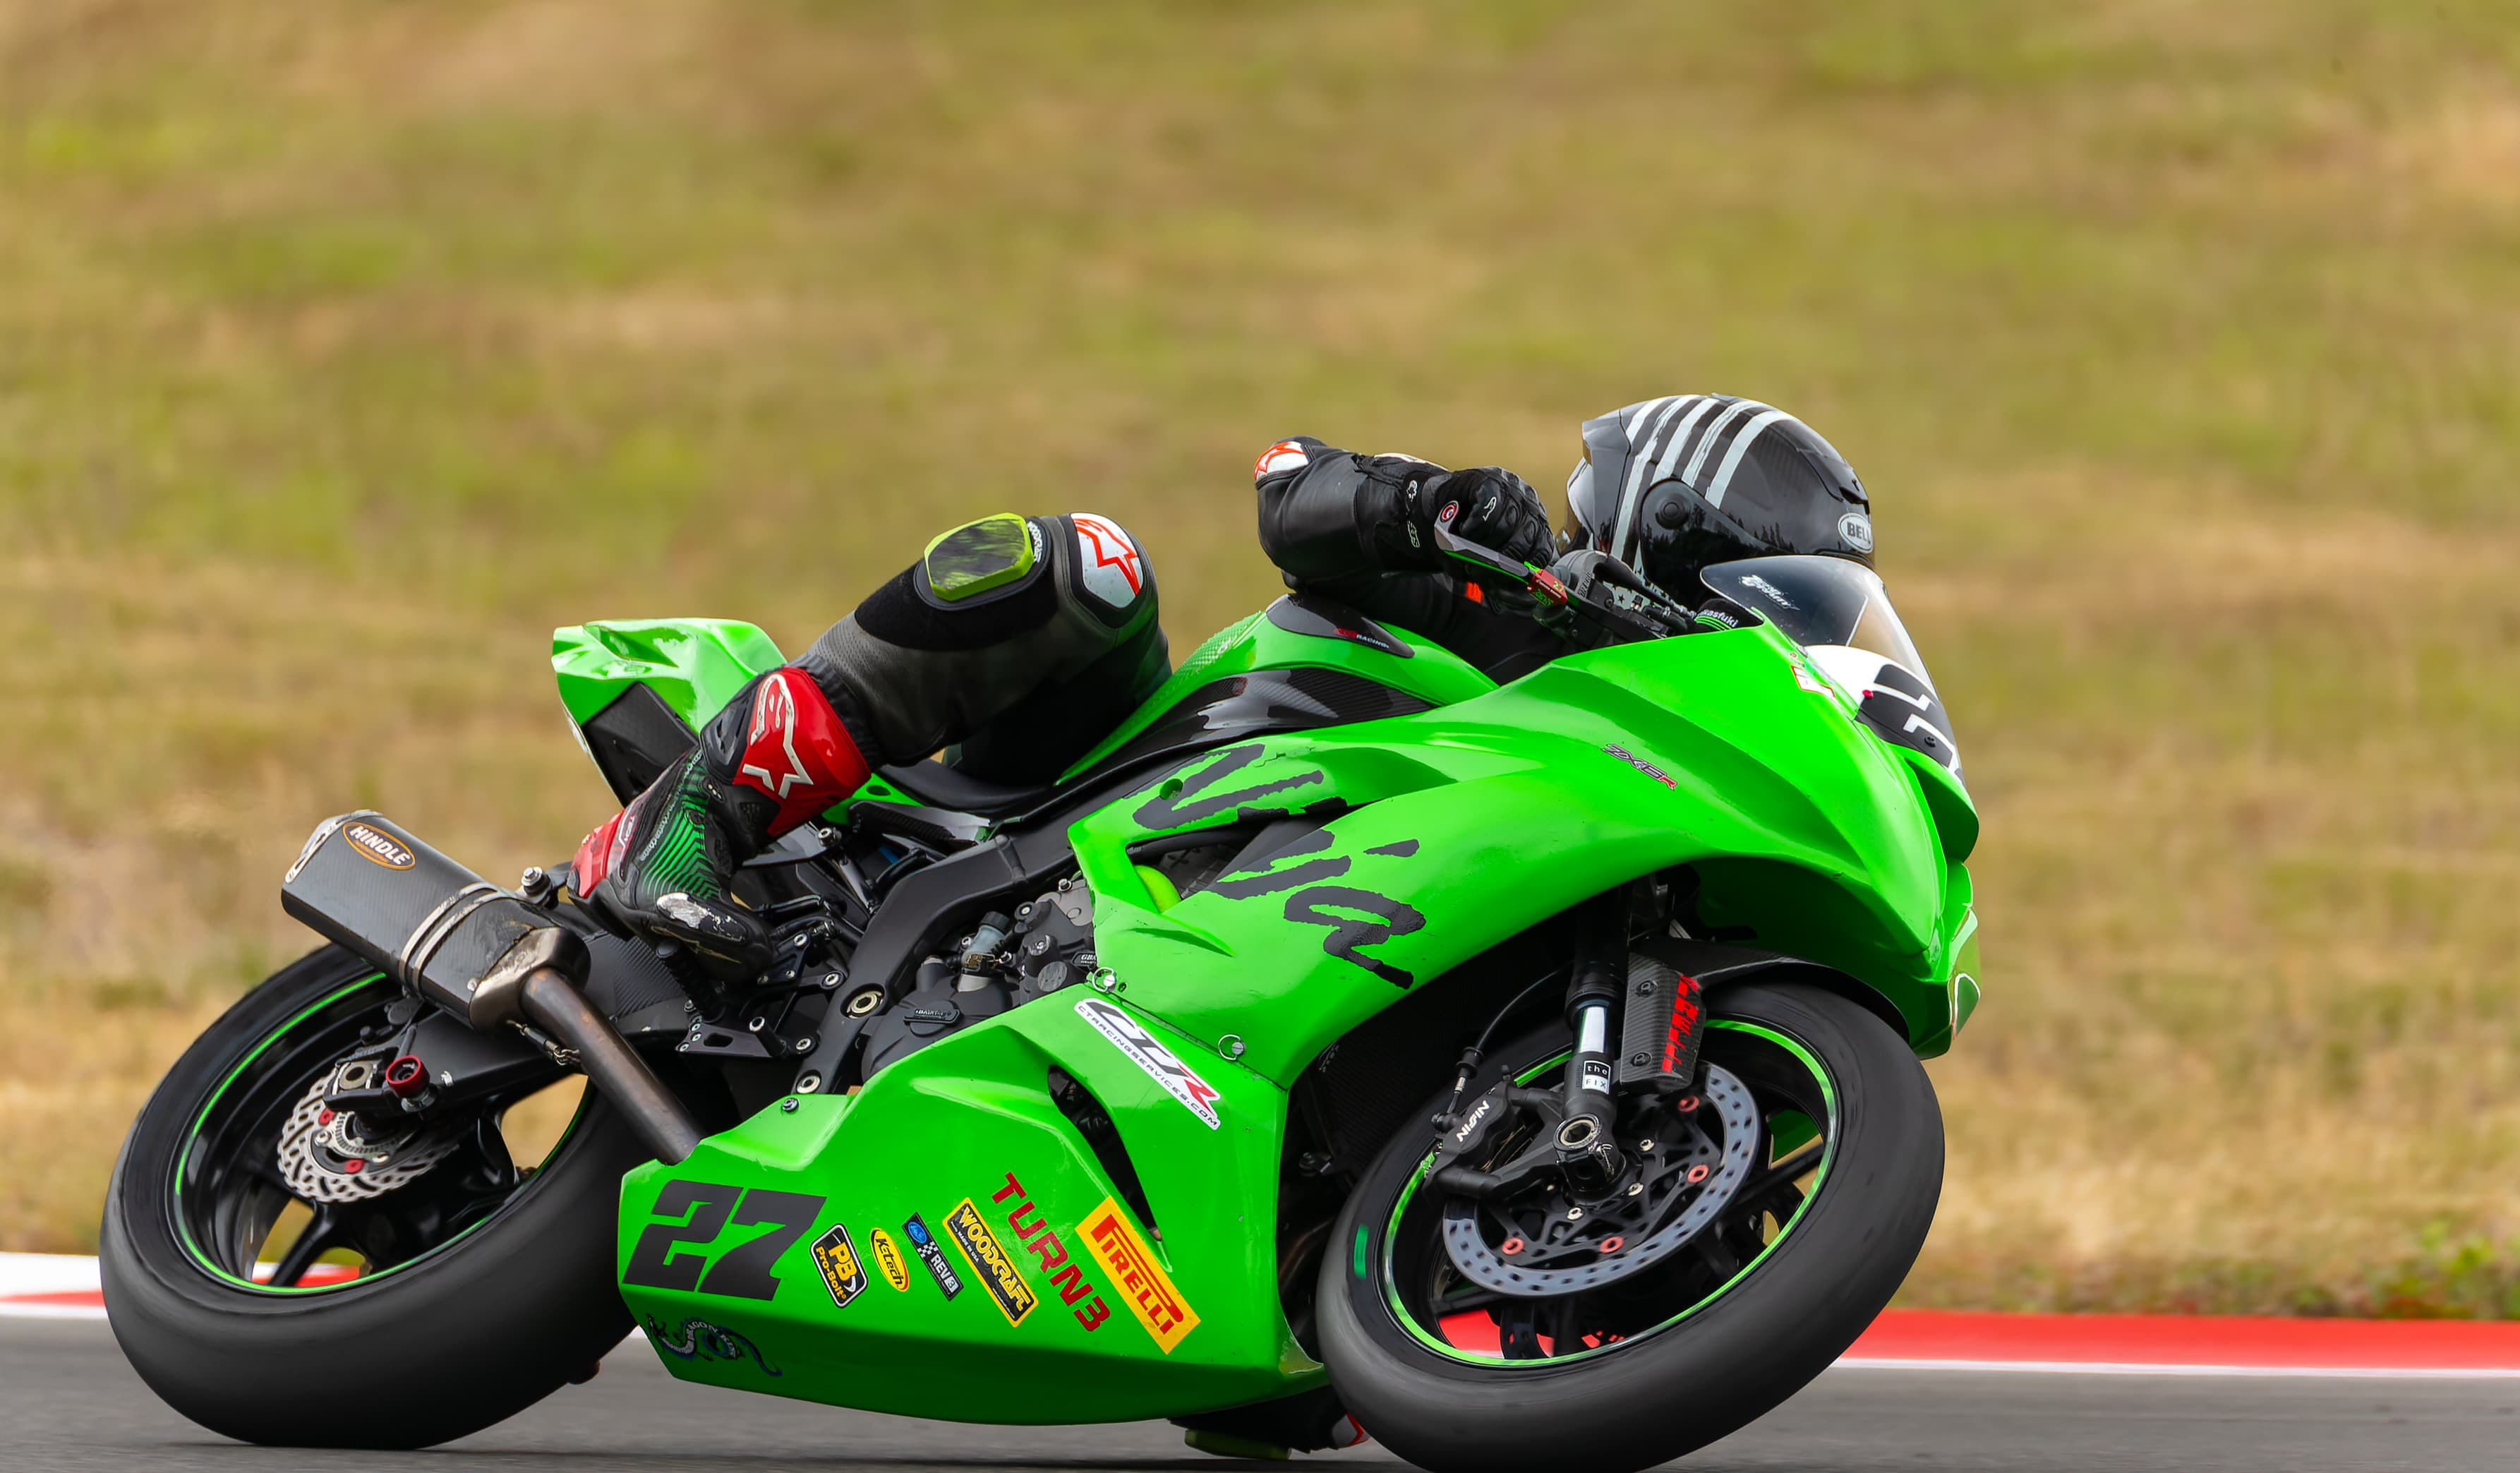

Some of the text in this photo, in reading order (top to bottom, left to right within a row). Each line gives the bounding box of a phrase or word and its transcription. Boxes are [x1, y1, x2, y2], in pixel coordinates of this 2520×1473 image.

[1847, 521, 1871, 545] BELL
[1356, 634, 1387, 648] RACING
[349, 825, 411, 865] HINDLE
[1078, 1005, 1219, 1127] CTRACINGSERVICES.COM
[1586, 1078, 1606, 1089] FIX
[1587, 1064, 1608, 1076] the
[622, 1179, 827, 1301] 27
[958, 1231, 969, 1246] MADE
[991, 1171, 1111, 1333] TURN3
[828, 1241, 857, 1282] PB
[959, 1206, 1031, 1312] WOODCRAFT
[1090, 1214, 1185, 1335] PIRELLI
